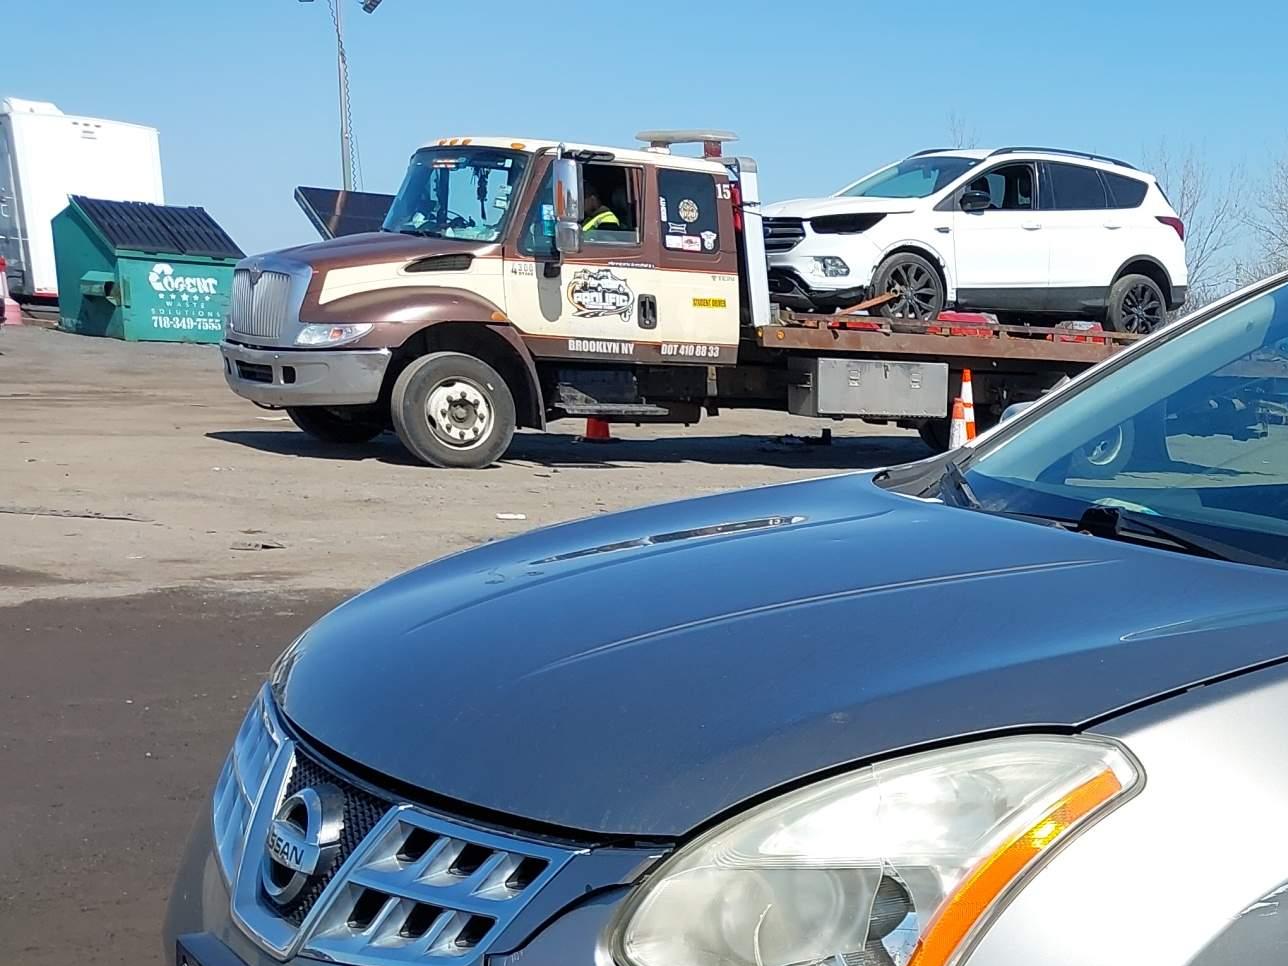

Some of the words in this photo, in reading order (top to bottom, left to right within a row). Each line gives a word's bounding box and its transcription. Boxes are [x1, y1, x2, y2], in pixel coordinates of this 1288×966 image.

[716, 183, 731, 199] 15
[165, 301, 205, 309] WASTE
[151, 308, 221, 318] SOLUTIONS
[152, 316, 222, 331] 718-349-7555
[568, 339, 620, 354] BROOKLYN
[621, 342, 634, 355] NY
[661, 343, 679, 355] DOT
[679, 345, 694, 356] 410
[707, 346, 720, 357] 33
